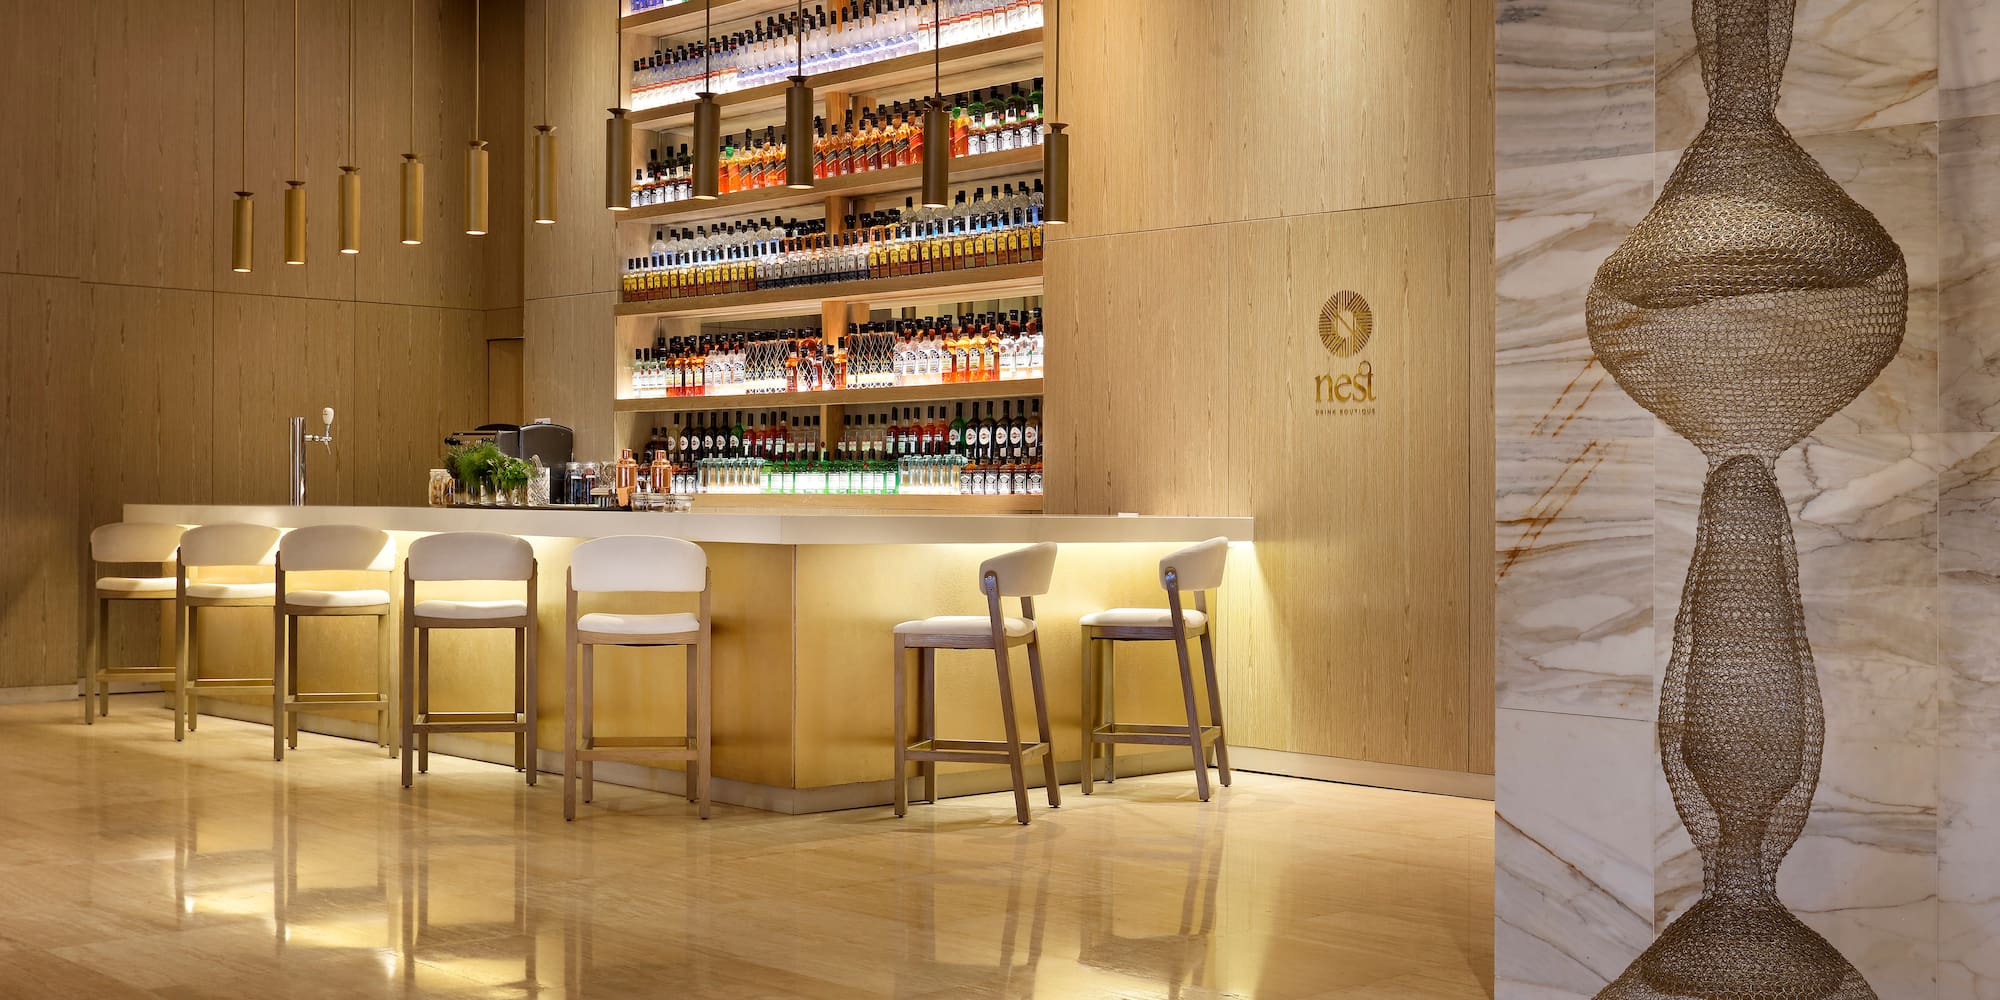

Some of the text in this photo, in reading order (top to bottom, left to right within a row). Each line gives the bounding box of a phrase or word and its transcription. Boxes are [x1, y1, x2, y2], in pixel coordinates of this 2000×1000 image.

[1315, 360, 1376, 402] nest
[1315, 408, 1375, 416] DRINK BOUTIQUE
